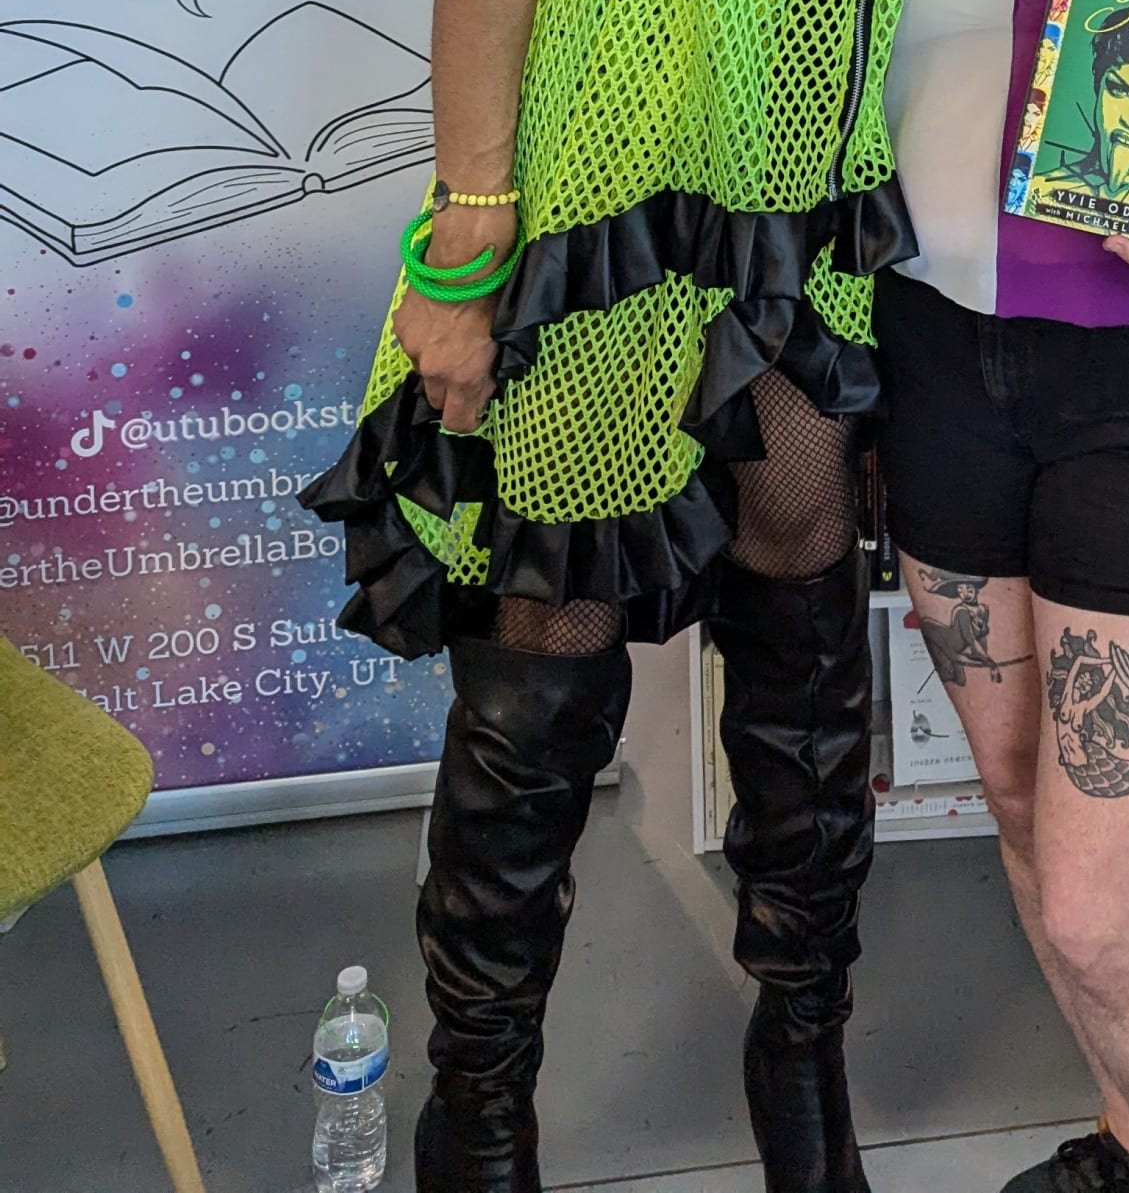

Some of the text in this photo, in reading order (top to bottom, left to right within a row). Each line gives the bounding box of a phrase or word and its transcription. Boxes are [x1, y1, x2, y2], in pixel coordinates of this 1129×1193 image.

[1057, 190, 1097, 209] YVIE
[1045, 208, 1061, 216] with
[1066, 211, 1127, 233] MICHAEL
[0, 530, 346, 588] ertheUmbrellaBo
[94, 635, 134, 665] W
[148, 629, 219, 659] 200
[233, 624, 257, 651] S
[74, 656, 403, 713] alt Lake City, UT
